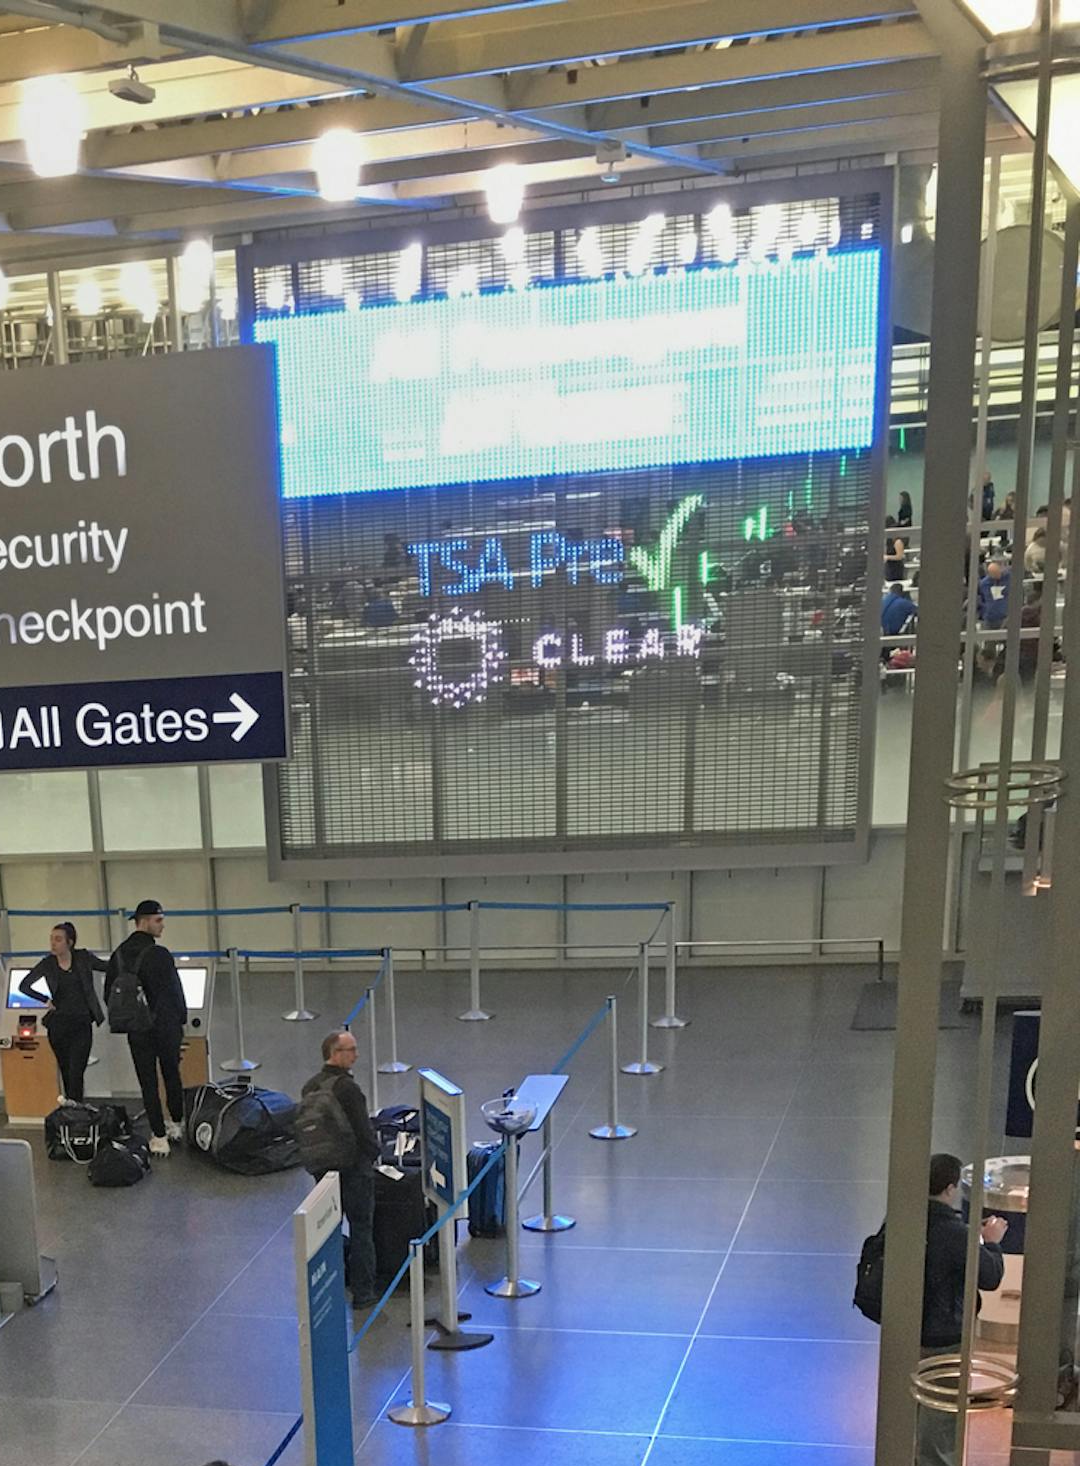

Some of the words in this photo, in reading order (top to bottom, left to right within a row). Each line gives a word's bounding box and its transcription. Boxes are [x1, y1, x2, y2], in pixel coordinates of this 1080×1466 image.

[407, 536, 514, 597] TSA
[530, 532, 625, 589] Pre
[532, 624, 703, 669] CLEAR
[8, 705, 61, 749] All
[75, 702, 210, 747] Gates
